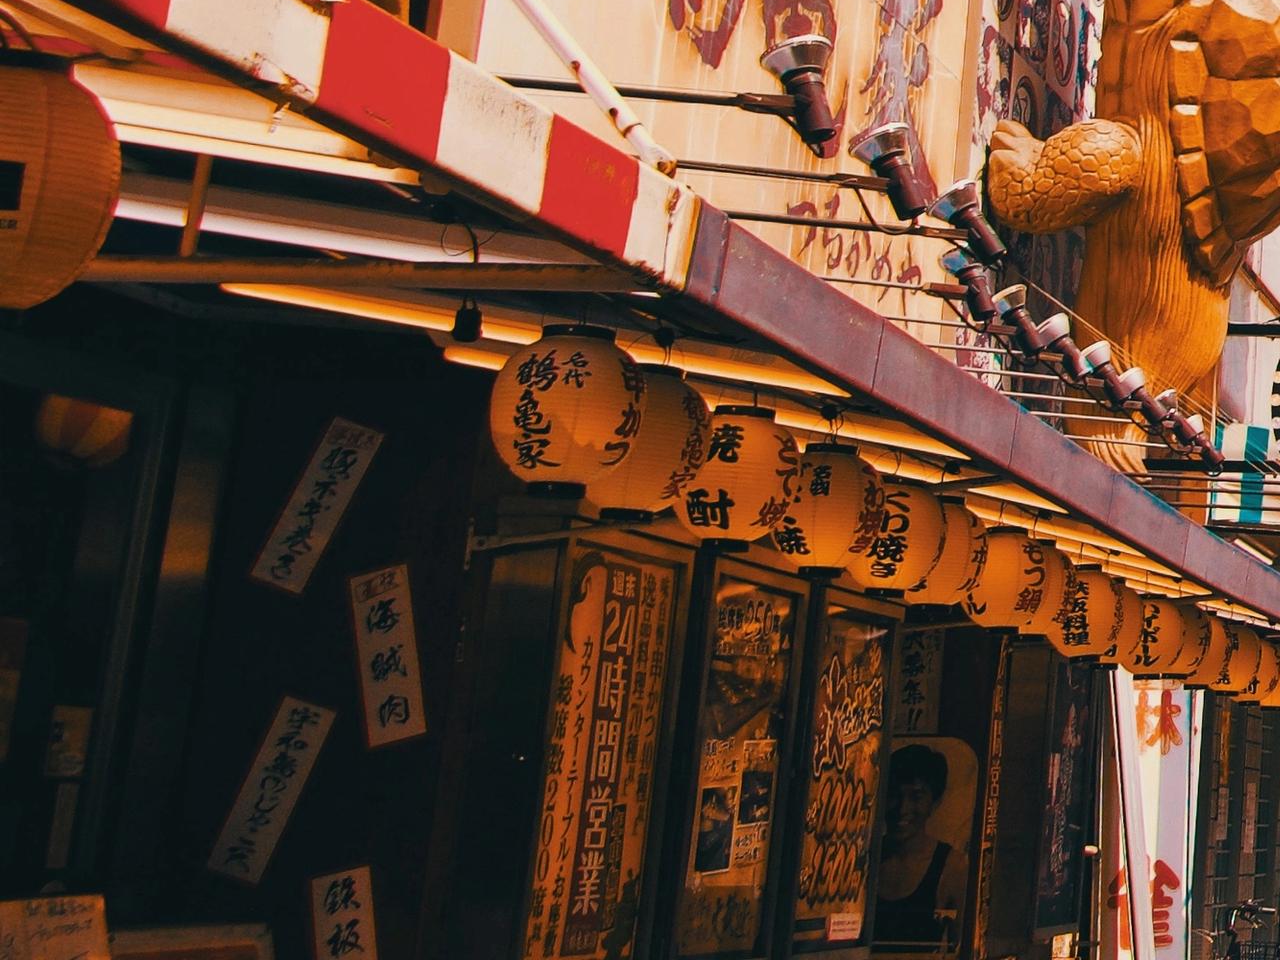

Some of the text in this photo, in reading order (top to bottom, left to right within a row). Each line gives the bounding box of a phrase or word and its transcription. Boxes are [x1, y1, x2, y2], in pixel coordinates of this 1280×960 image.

[512, 348, 563, 470] 鶴亀家
[560, 350, 593, 389] 名代
